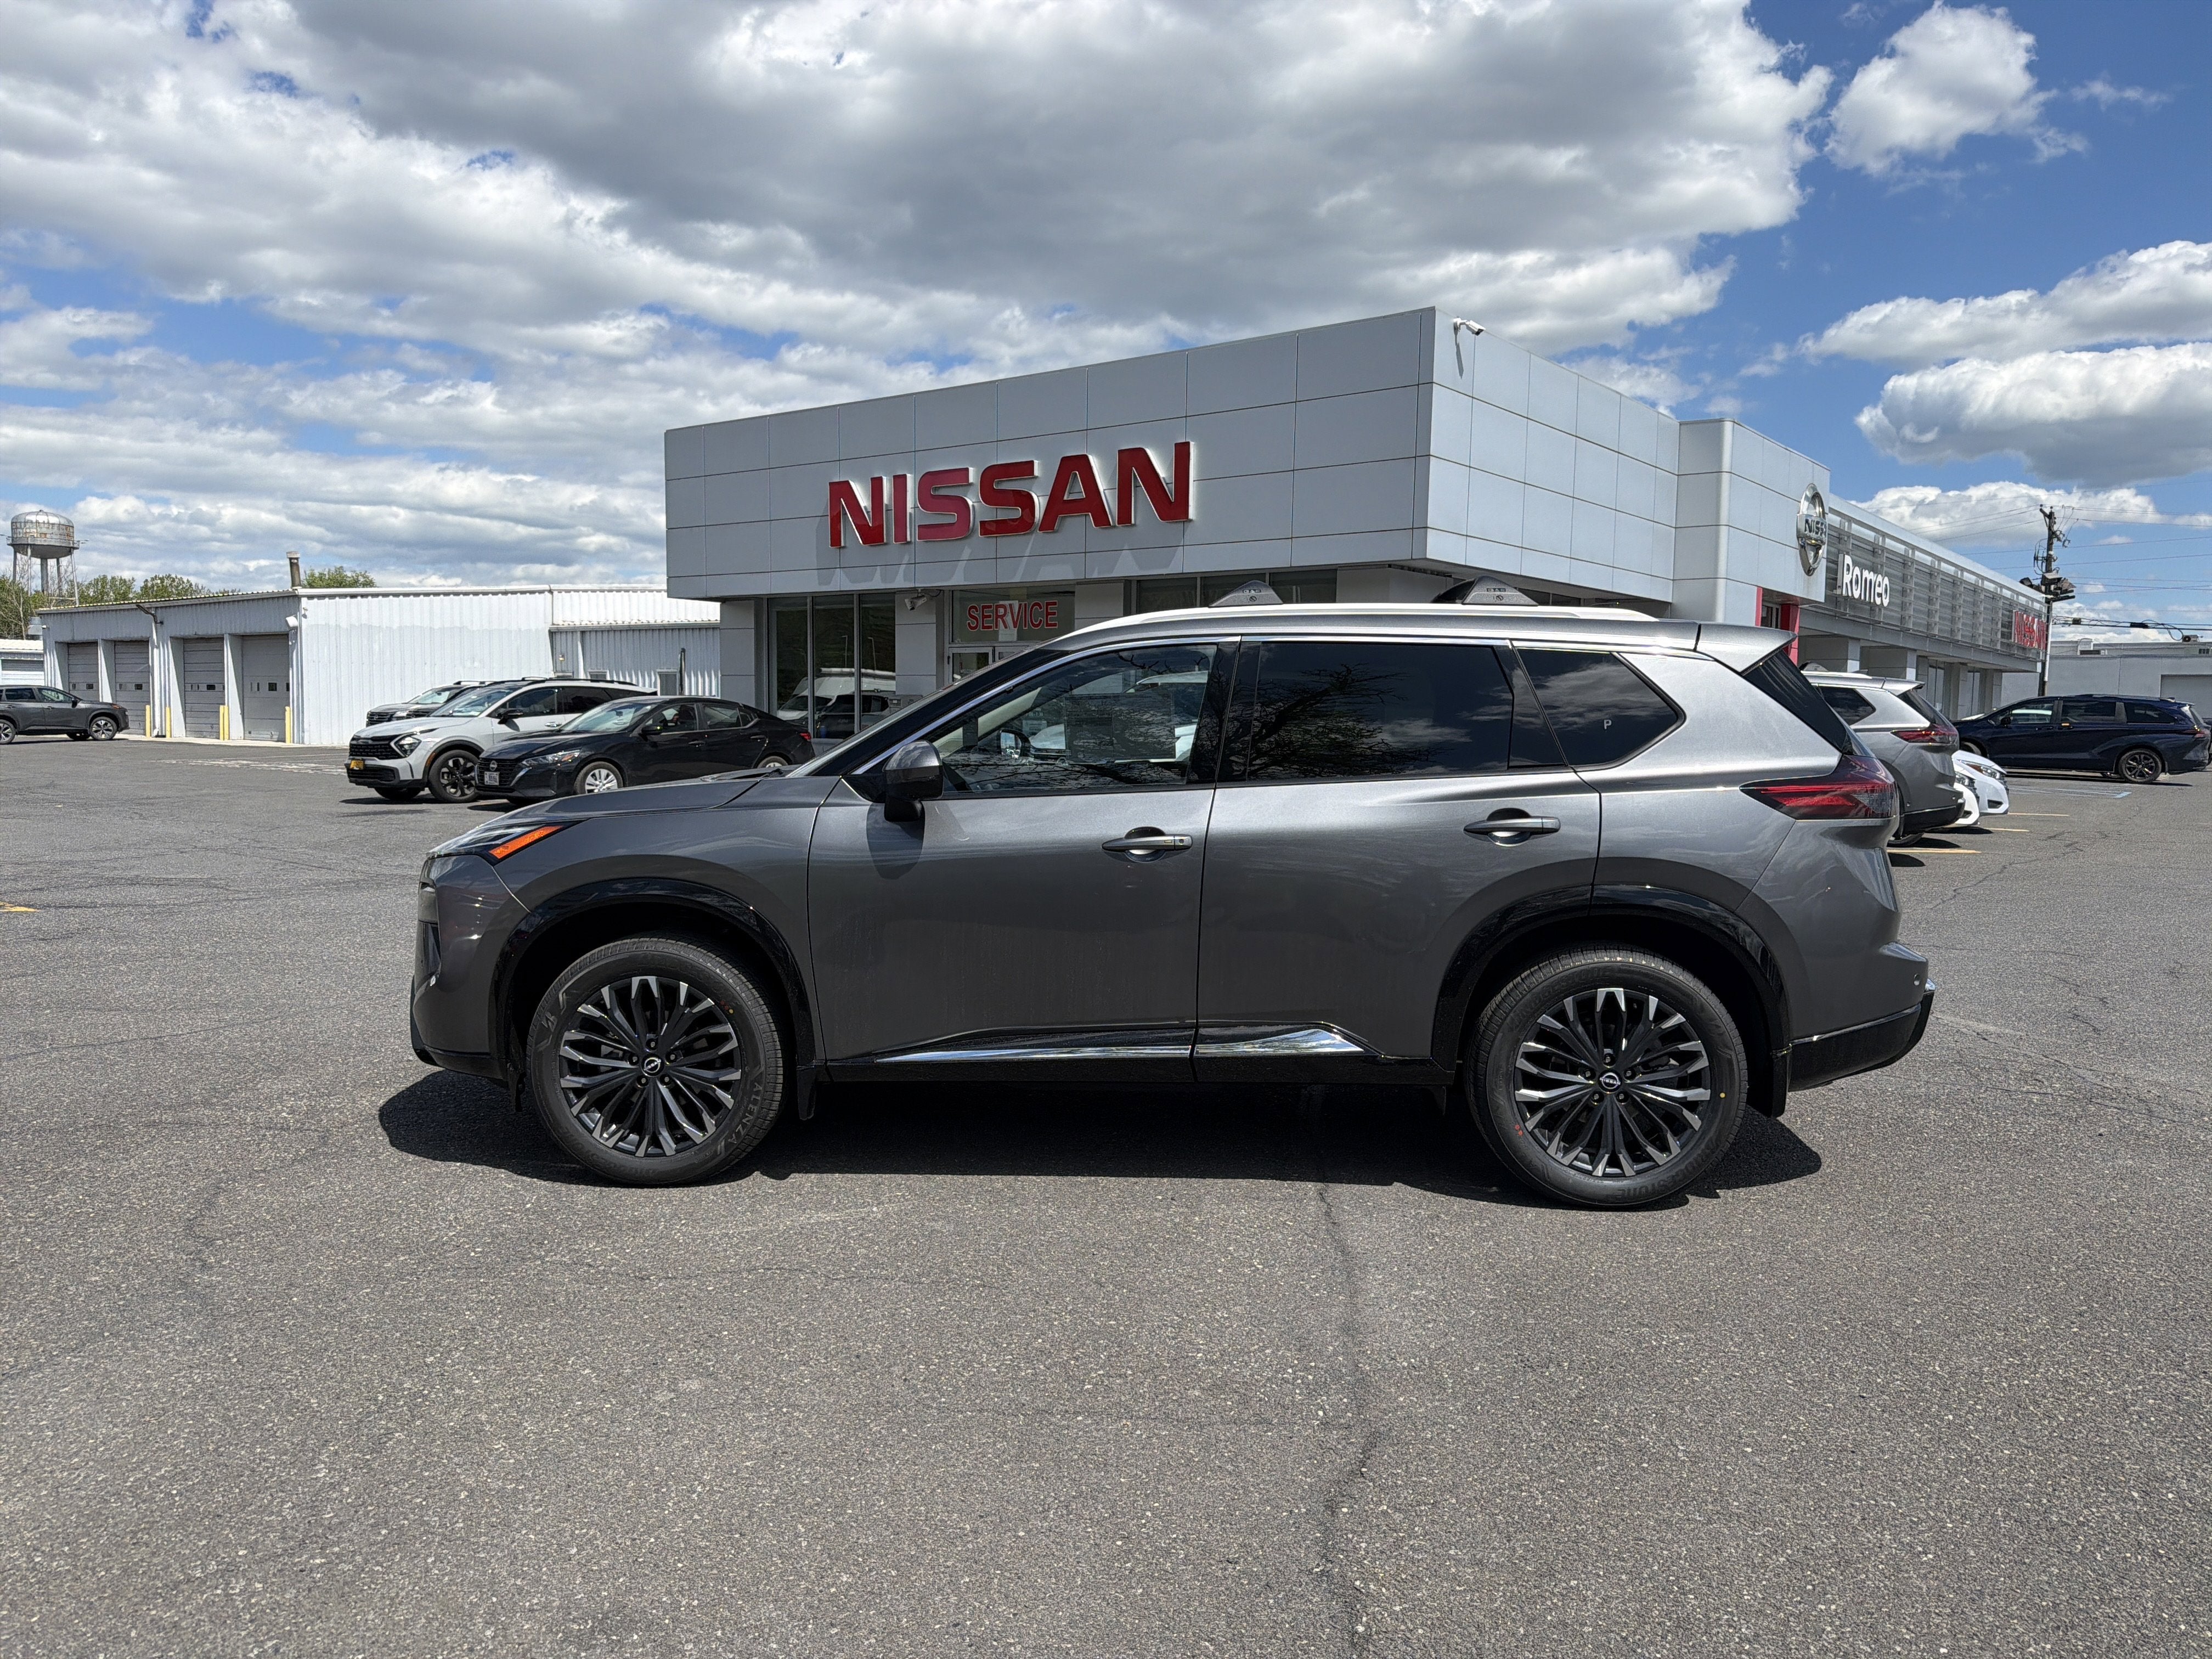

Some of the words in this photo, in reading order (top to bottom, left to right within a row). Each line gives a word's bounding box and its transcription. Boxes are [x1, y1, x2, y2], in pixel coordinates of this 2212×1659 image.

[828, 441, 1193, 548] NISSAN
[1804, 518, 1827, 538] NISS
[1842, 554, 1889, 607] Romeo
[967, 600, 1058, 631] SERVICE
[1604, 719, 1612, 730] P
[1599, 1077, 1621, 1085] NISSAN
[727, 1082, 763, 1144] ALENZA
